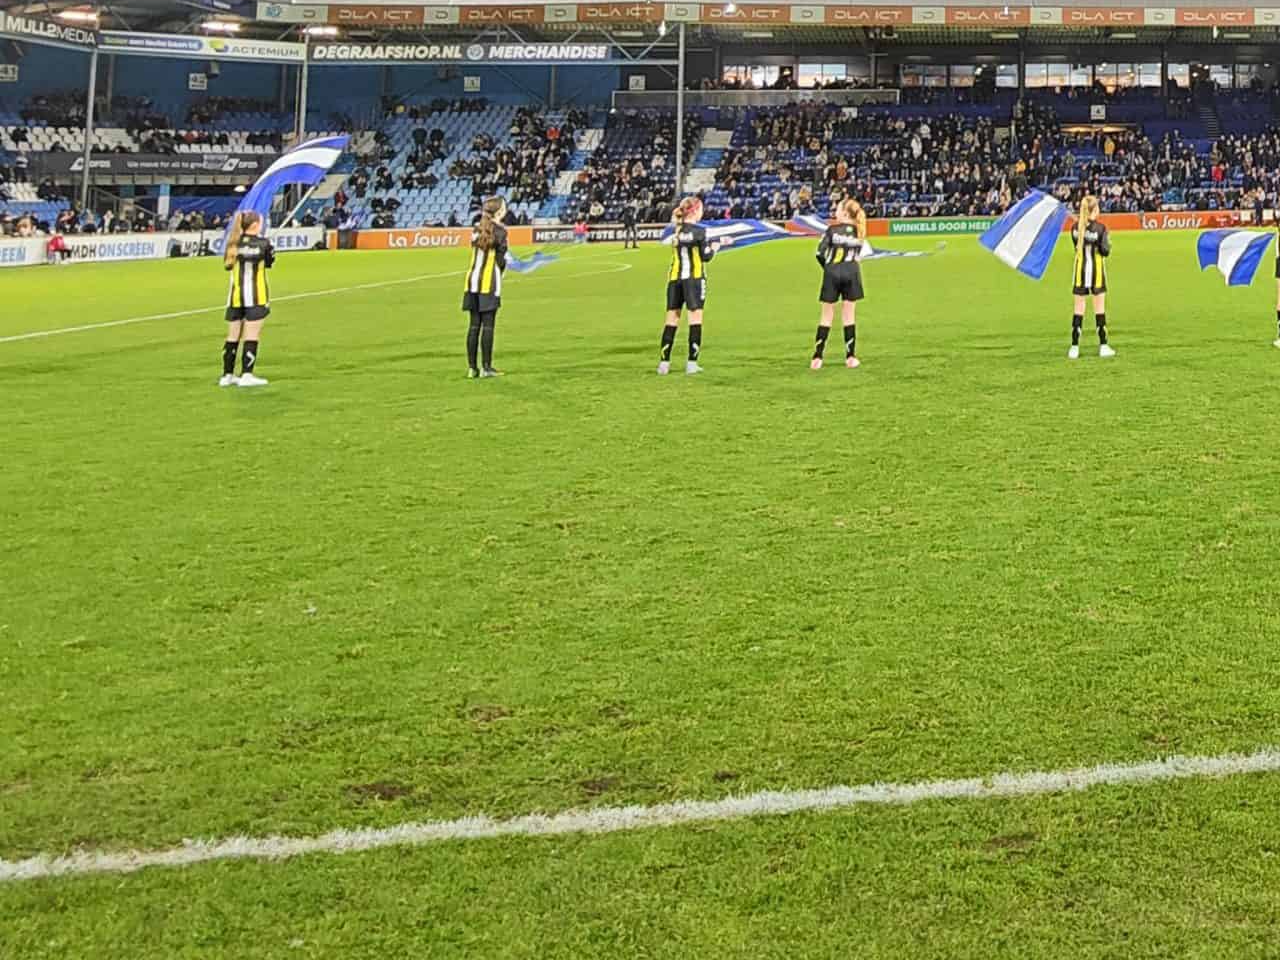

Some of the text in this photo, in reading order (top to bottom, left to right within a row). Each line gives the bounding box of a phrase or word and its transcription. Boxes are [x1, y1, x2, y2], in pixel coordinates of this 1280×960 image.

[338, 9, 413, 20] DLA ICT
[6, 15, 97, 45] MULL2MEDIA
[231, 45, 300, 58] ACTEMIUM
[313, 45, 608, 60] DEGRAAFSHOP.NL MERCHANDISE
[892, 223, 937, 233] WINKELS
[938, 222, 967, 232] DOOR
[1142, 215, 1158, 229] La
[1161, 214, 1203, 228] Souris
[388, 231, 462, 248] La Souris
